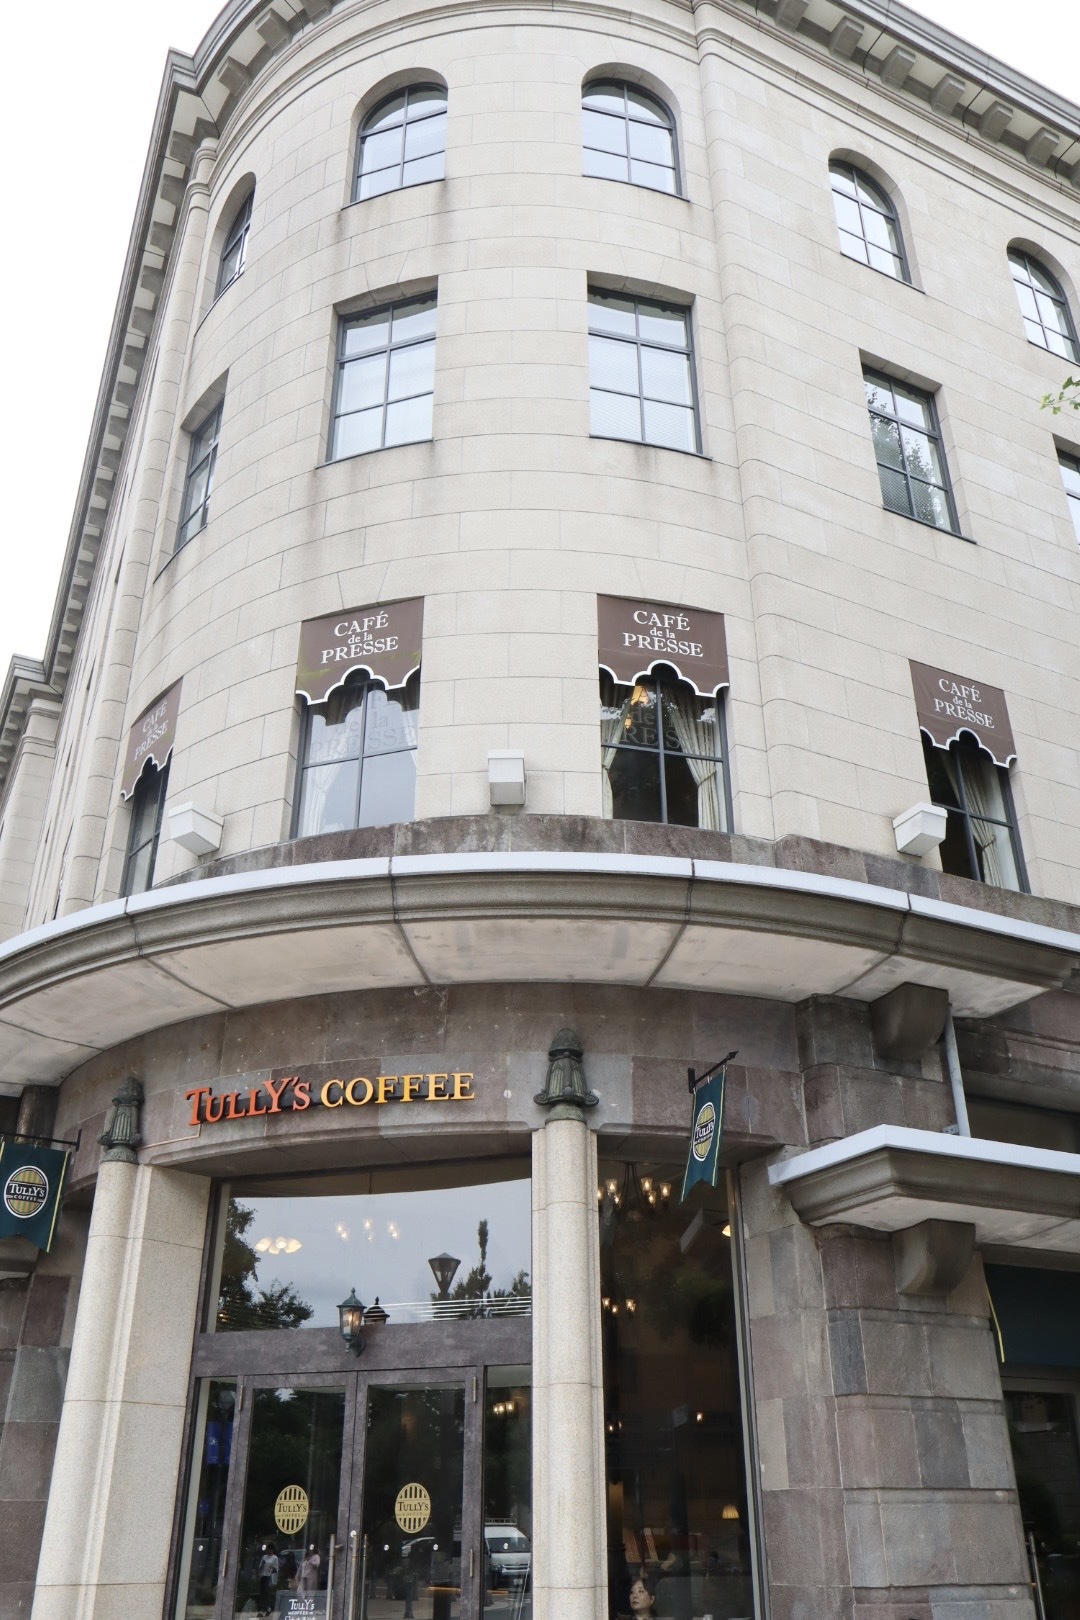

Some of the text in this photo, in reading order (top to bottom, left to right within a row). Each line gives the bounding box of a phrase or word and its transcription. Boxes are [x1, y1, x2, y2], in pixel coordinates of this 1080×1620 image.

[334, 610, 389, 637] CAFÉ
[633, 610, 690, 631] CAFÉ
[650, 627, 676, 639] de la
[320, 636, 399, 664] PRESSE
[347, 632, 373, 645] de la
[622, 632, 704, 658] PRESSE
[938, 678, 982, 703] CAFÉ
[952, 696, 973, 709] de la
[933, 698, 995, 729] PRESSE
[134, 719, 169, 761] PRESSE
[320, 1072, 475, 1108] COFFEE
[14, 1194, 37, 1202] COFFEE
